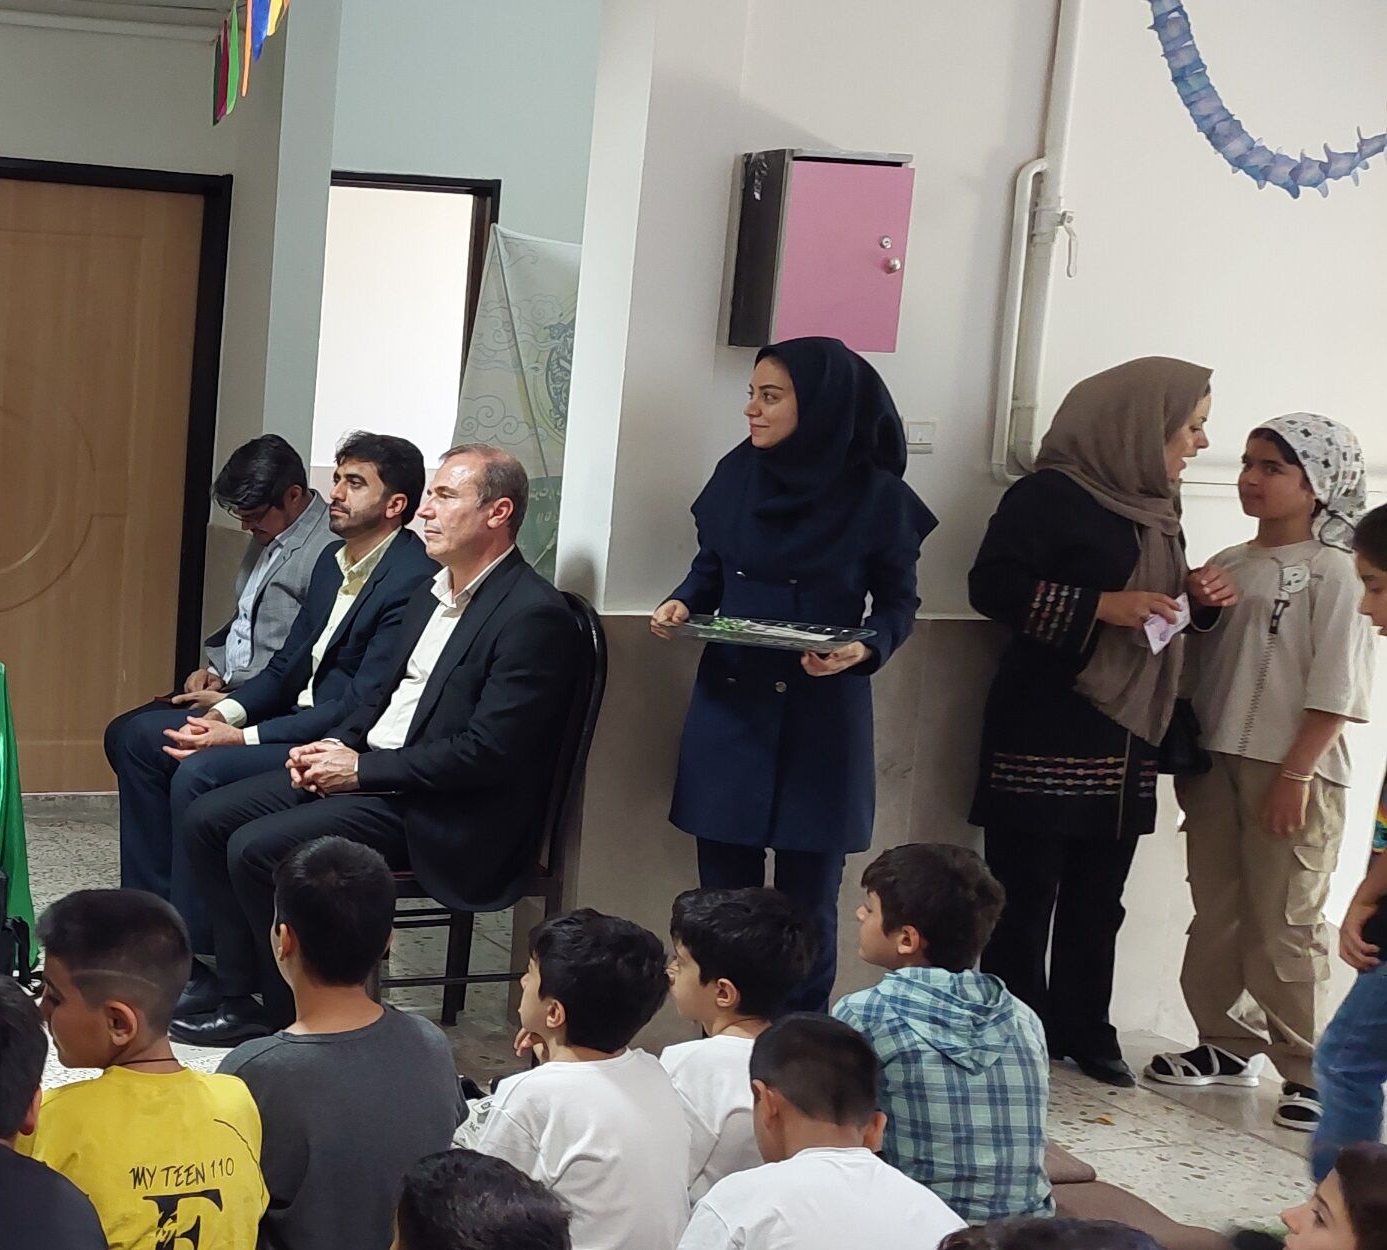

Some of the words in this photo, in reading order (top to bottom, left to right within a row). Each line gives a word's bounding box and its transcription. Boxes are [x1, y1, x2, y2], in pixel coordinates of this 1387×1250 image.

[129, 1165, 157, 1190] MY
[161, 1163, 206, 1188] TEEN
[210, 1157, 235, 1179] 110
